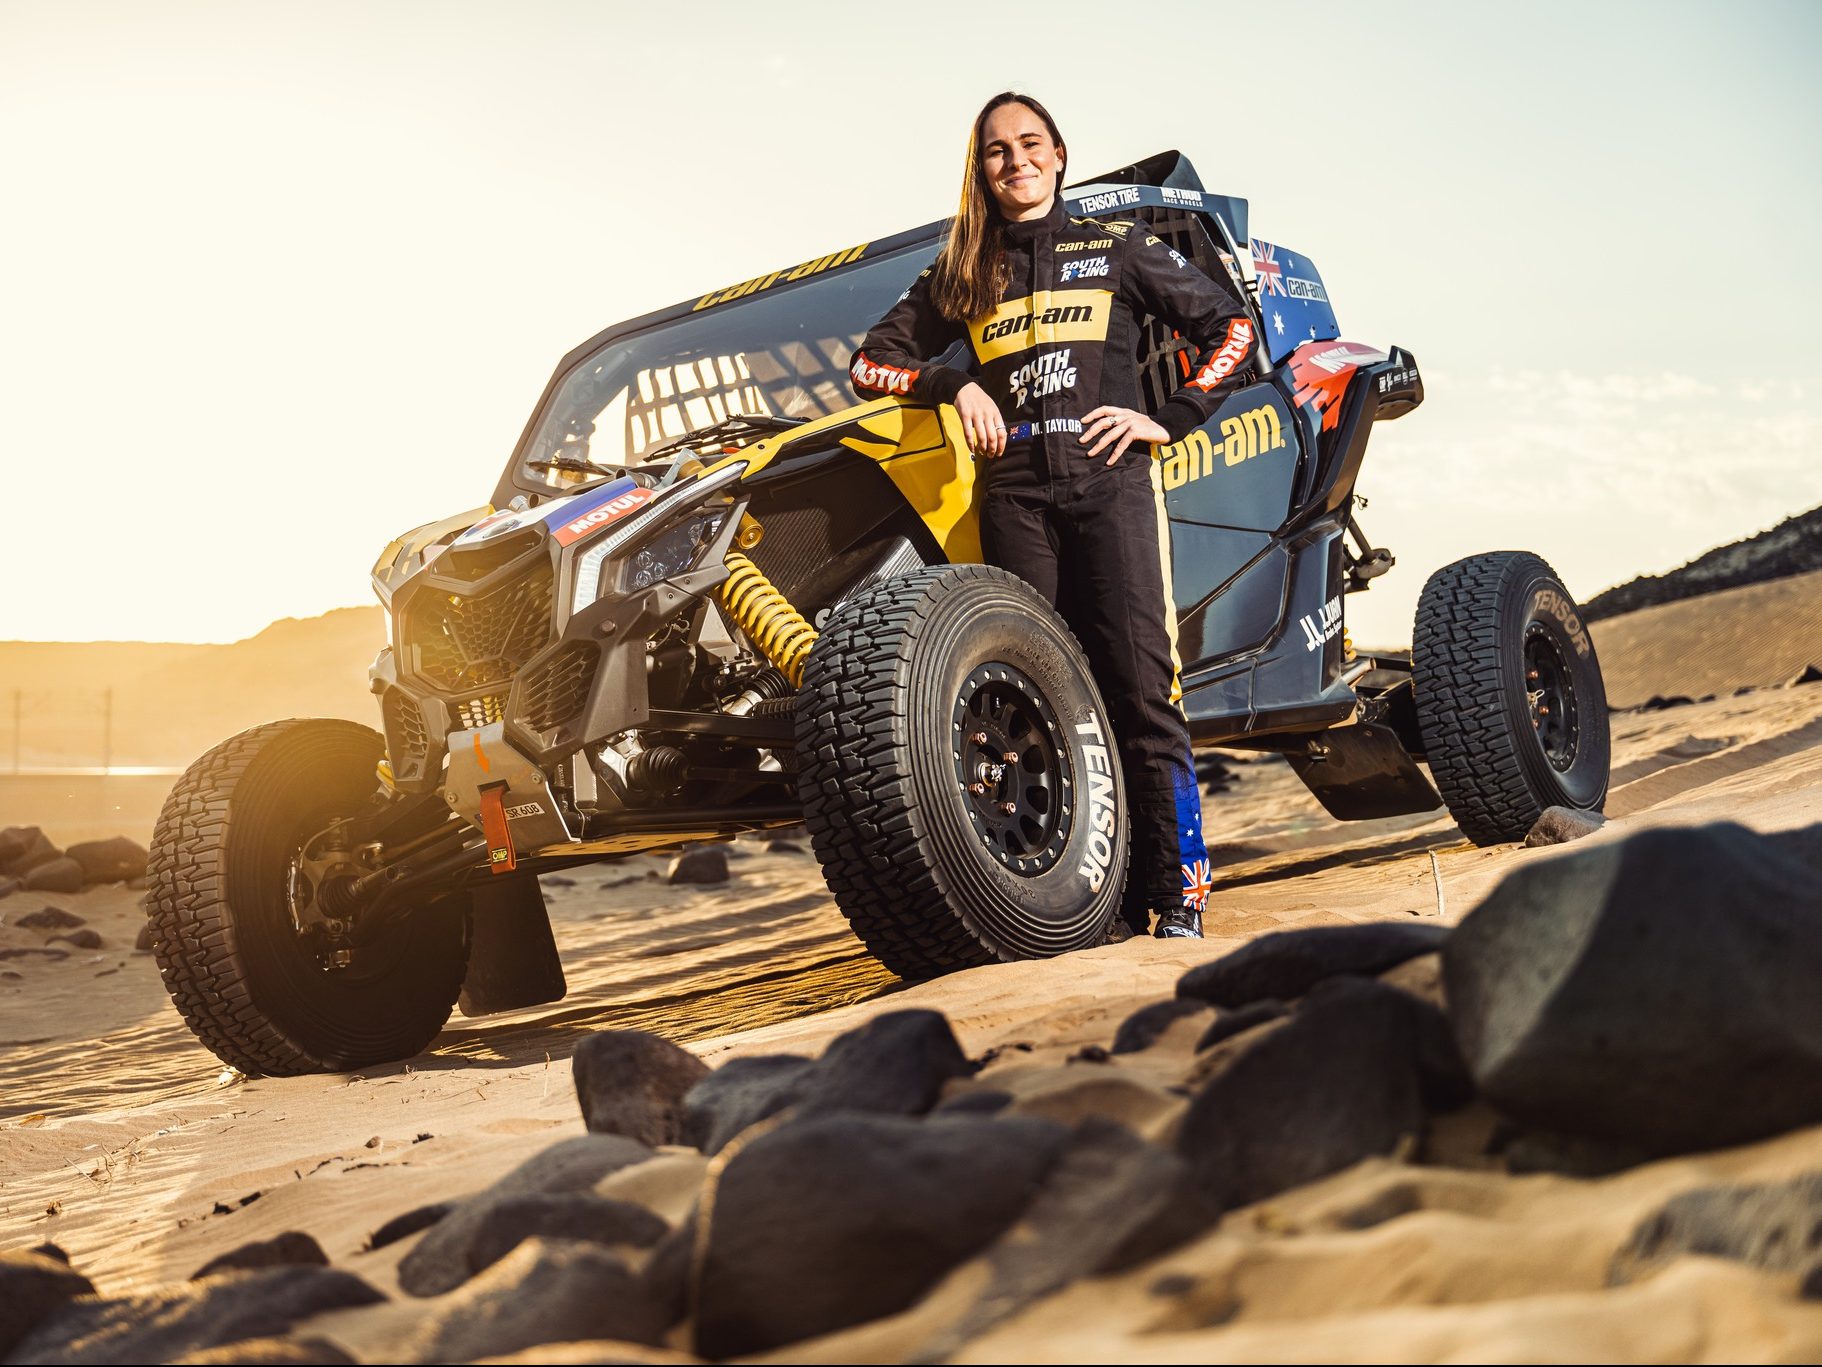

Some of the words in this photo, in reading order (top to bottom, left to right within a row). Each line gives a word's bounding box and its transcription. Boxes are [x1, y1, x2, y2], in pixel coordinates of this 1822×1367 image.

[1079, 191, 1119, 213] TENSOR
[1117, 187, 1140, 206] TIRE
[1055, 239, 1113, 252] can-am
[1061, 256, 1107, 272] SOUTH
[1287, 279, 1326, 300] can-am
[1009, 349, 1071, 393] SOUTH
[1045, 418, 1083, 433] TAYLOR
[568, 494, 646, 534] MOTUL
[1534, 589, 1590, 657] TENSOR
[506, 807, 521, 818] SR
[520, 804, 540, 815] 608
[1074, 711, 1116, 894] TENSOR
[492, 850, 508, 861] OMP
